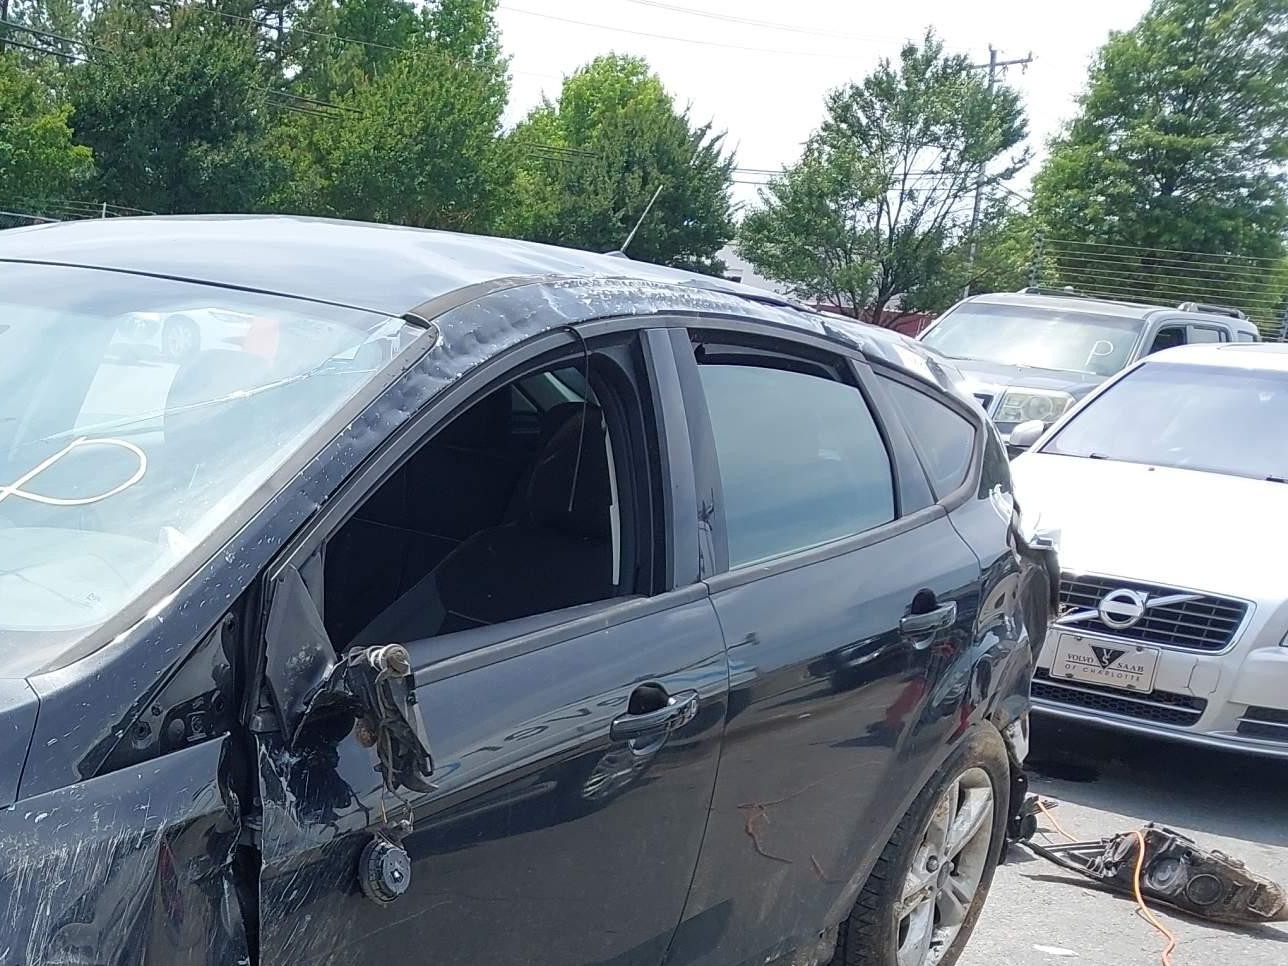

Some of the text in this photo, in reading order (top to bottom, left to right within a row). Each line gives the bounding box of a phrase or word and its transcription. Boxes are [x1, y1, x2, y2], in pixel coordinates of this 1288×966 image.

[1084, 339, 1114, 367] P
[1067, 653, 1145, 673] VOLVO SAAB
[1083, 667, 1140, 680] CHARLOTTE
